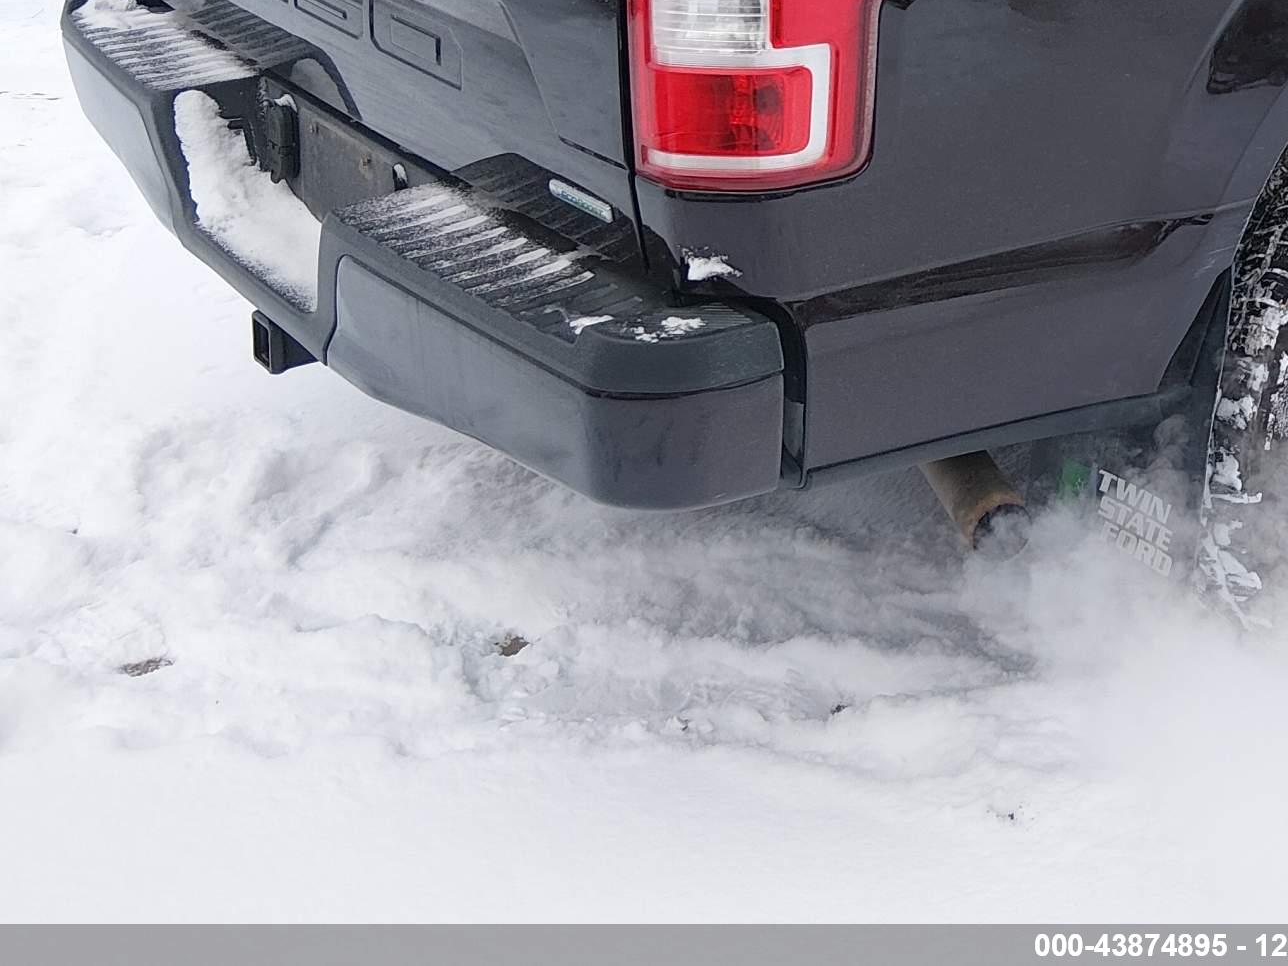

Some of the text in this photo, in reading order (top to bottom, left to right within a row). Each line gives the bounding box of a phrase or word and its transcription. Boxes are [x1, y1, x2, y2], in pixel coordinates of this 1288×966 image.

[1098, 469, 1172, 524] TWIN
[1098, 495, 1173, 552] STATE
[1101, 521, 1173, 576] FORD
